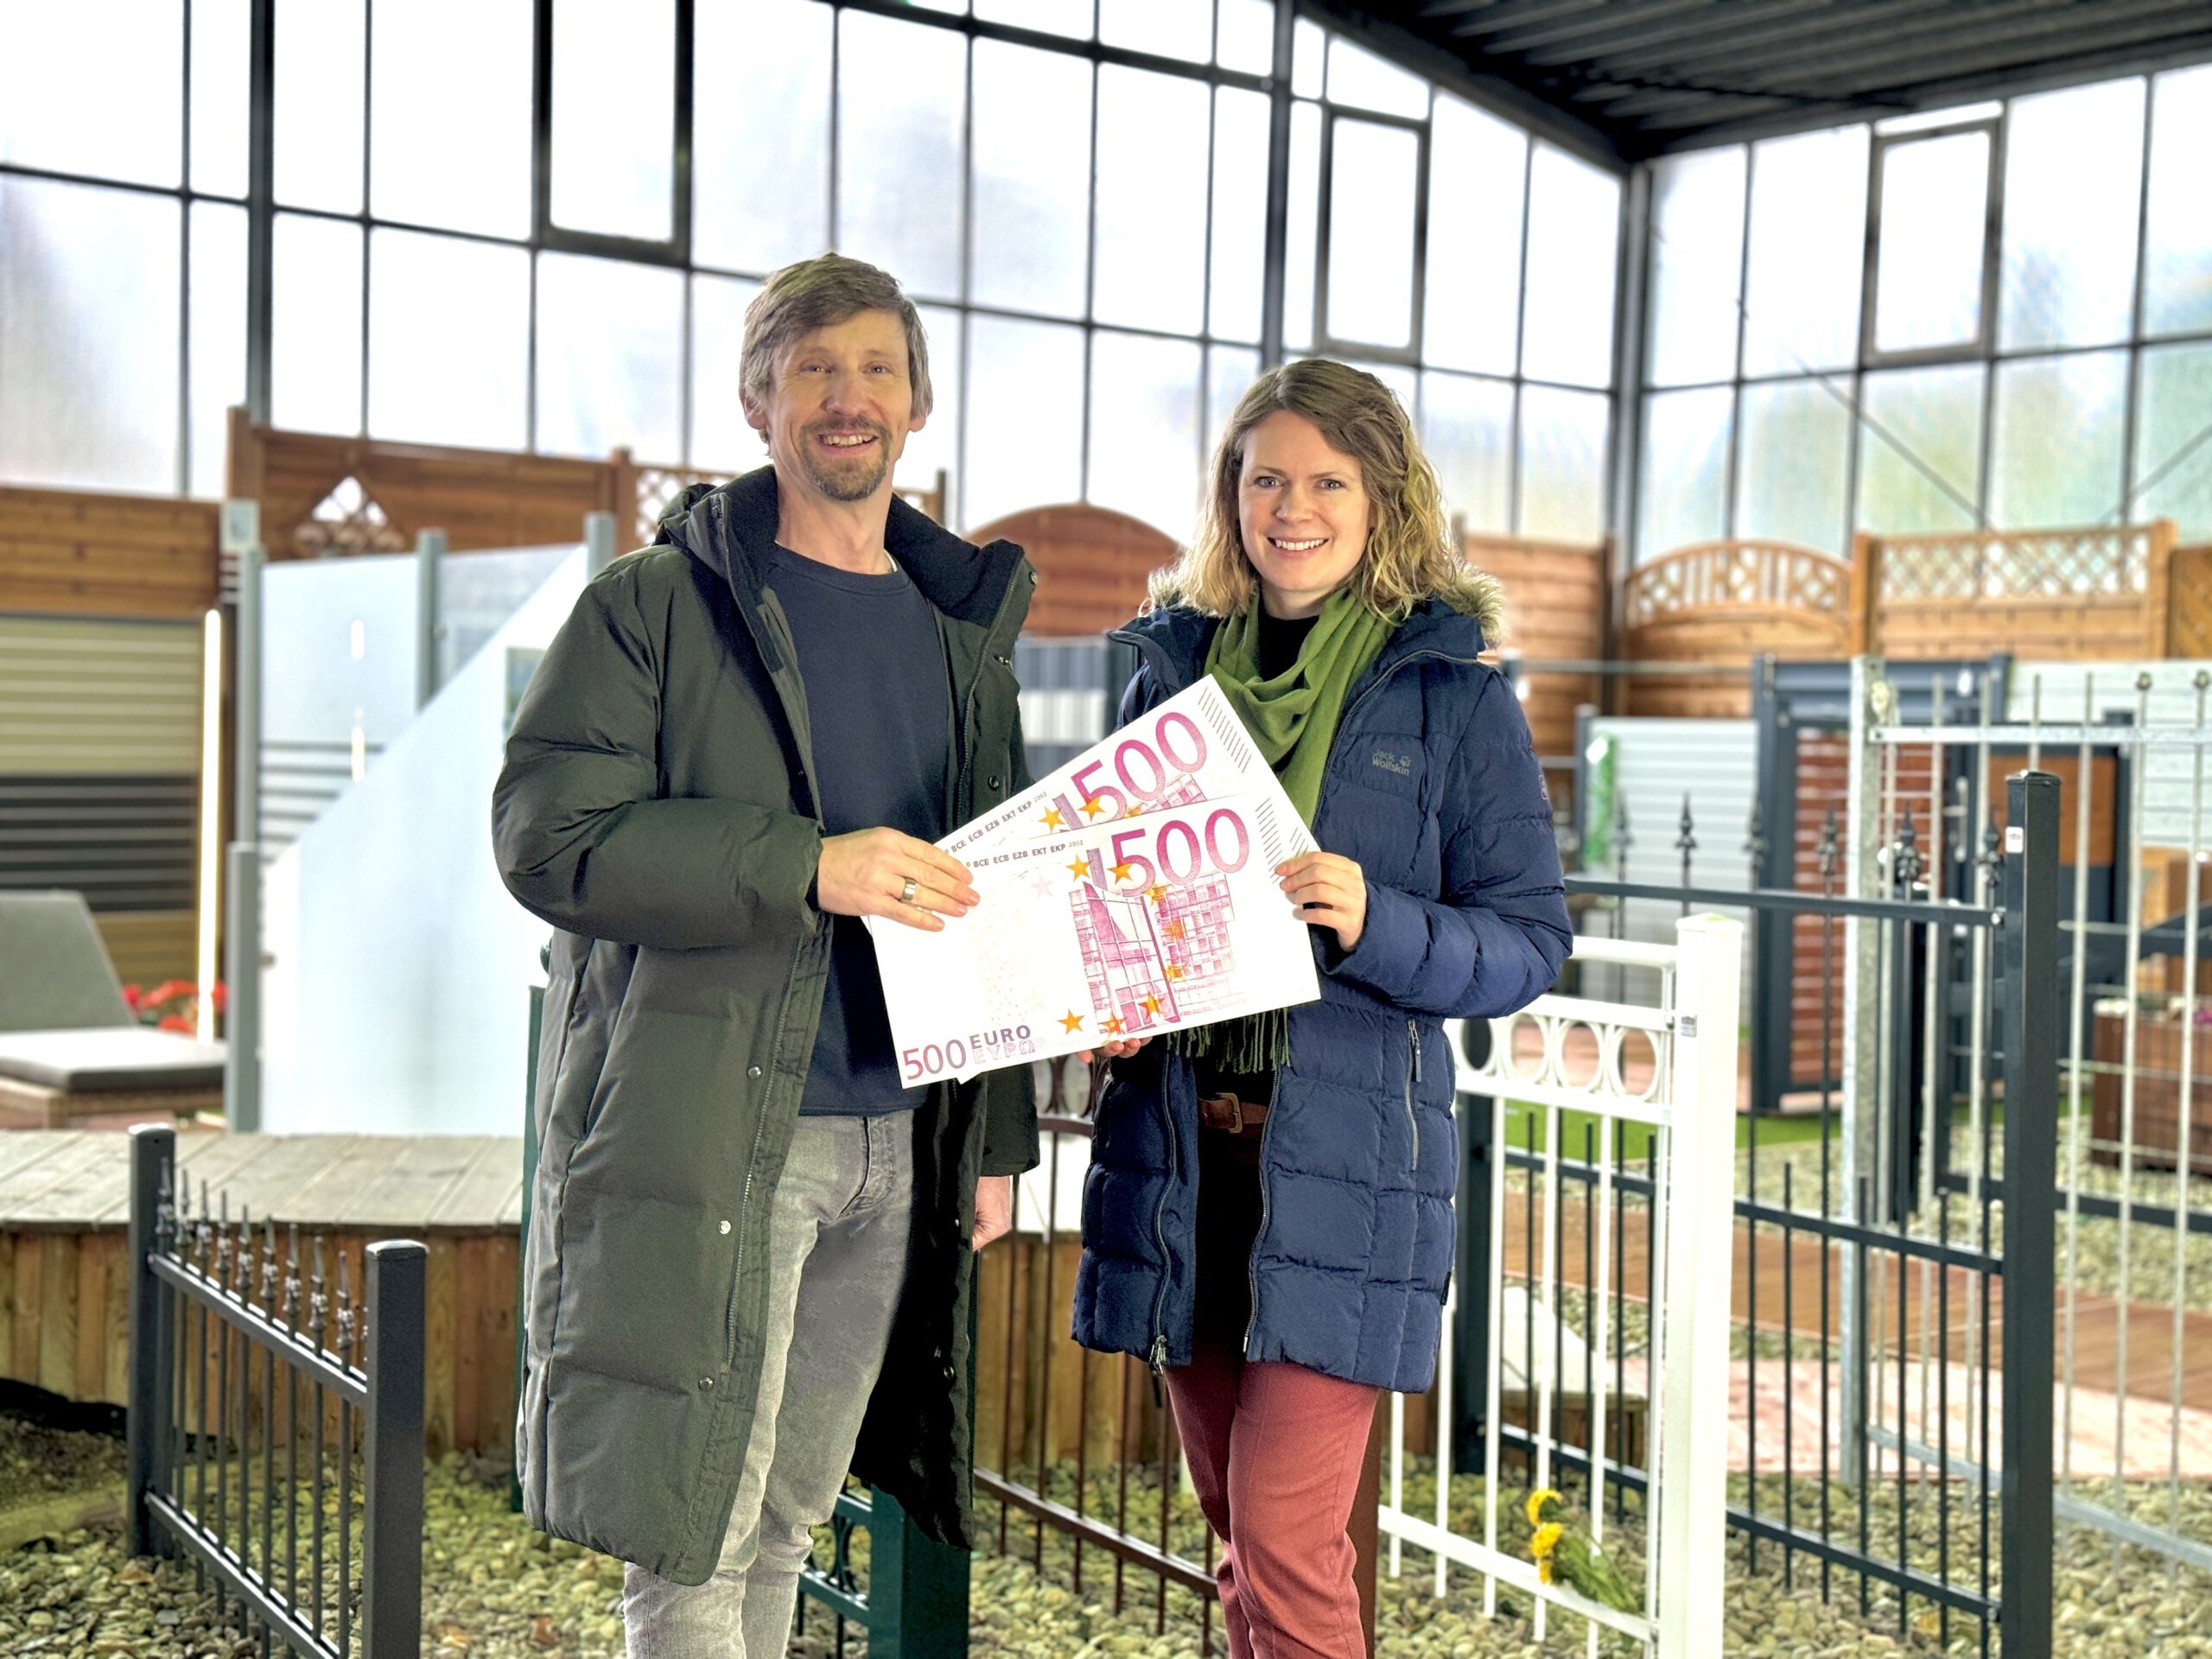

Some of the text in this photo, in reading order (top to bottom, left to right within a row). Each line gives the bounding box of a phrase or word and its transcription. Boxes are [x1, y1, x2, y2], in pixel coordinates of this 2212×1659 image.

[1071, 712, 1208, 822] 500
[1372, 756, 1410, 776] Wolfskin
[1373, 749, 1396, 761] Jack
[951, 840, 967, 853] BCE
[968, 829, 983, 842] ECB
[985, 821, 1000, 832] EZB
[1001, 810, 1017, 823] EKT
[1018, 800, 1033, 813] EKP
[1111, 808, 1250, 898] 500
[973, 859, 989, 868] BCE
[994, 855, 1009, 864] ECB
[1013, 851, 1028, 860] EZB
[1032, 847, 1047, 856] EKT
[1051, 843, 1065, 853] EKP
[902, 1025, 1031, 1080] 500 EURO
